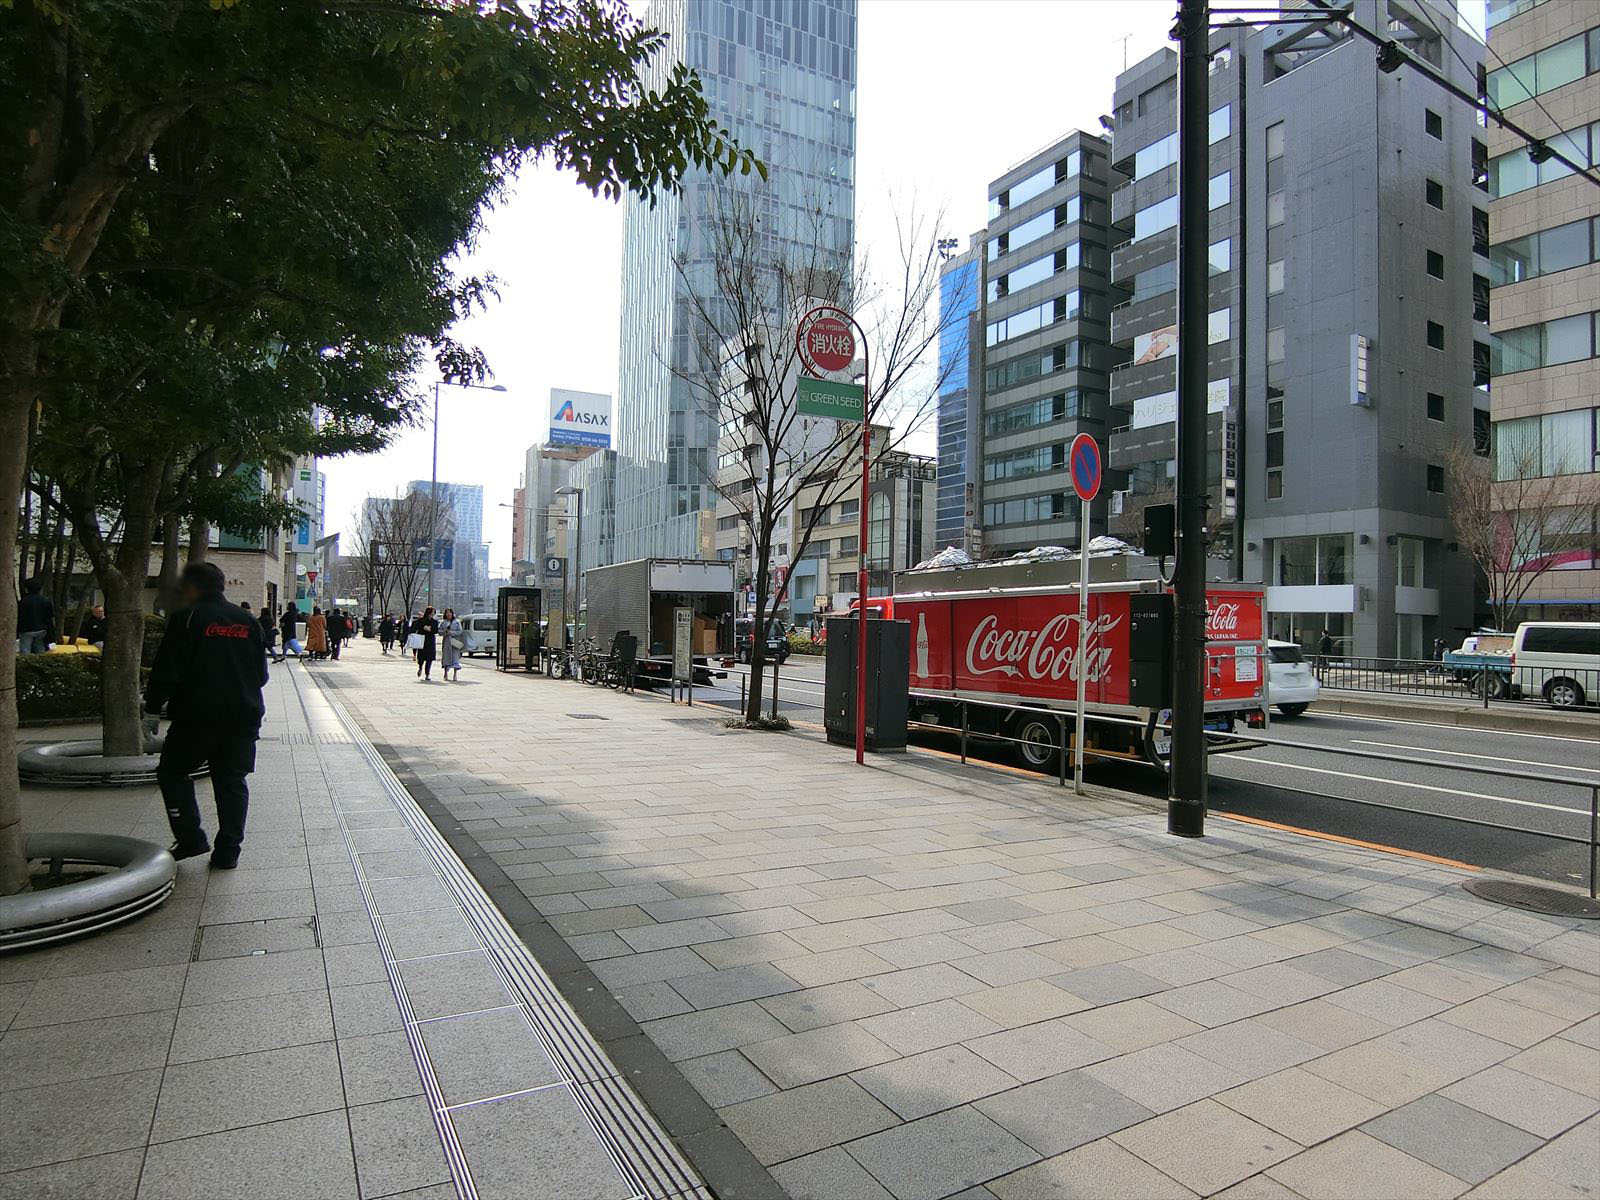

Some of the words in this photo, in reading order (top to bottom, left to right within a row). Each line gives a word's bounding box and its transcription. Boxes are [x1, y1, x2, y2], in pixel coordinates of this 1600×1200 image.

[811, 332, 852, 356] 消火栓
[810, 392, 839, 406] GREEN
[840, 396, 861, 409] SEED
[575, 412, 608, 427] ASAX
[205, 624, 249, 638] Coca-Cola
[966, 613, 1123, 682] Coca-Cola
